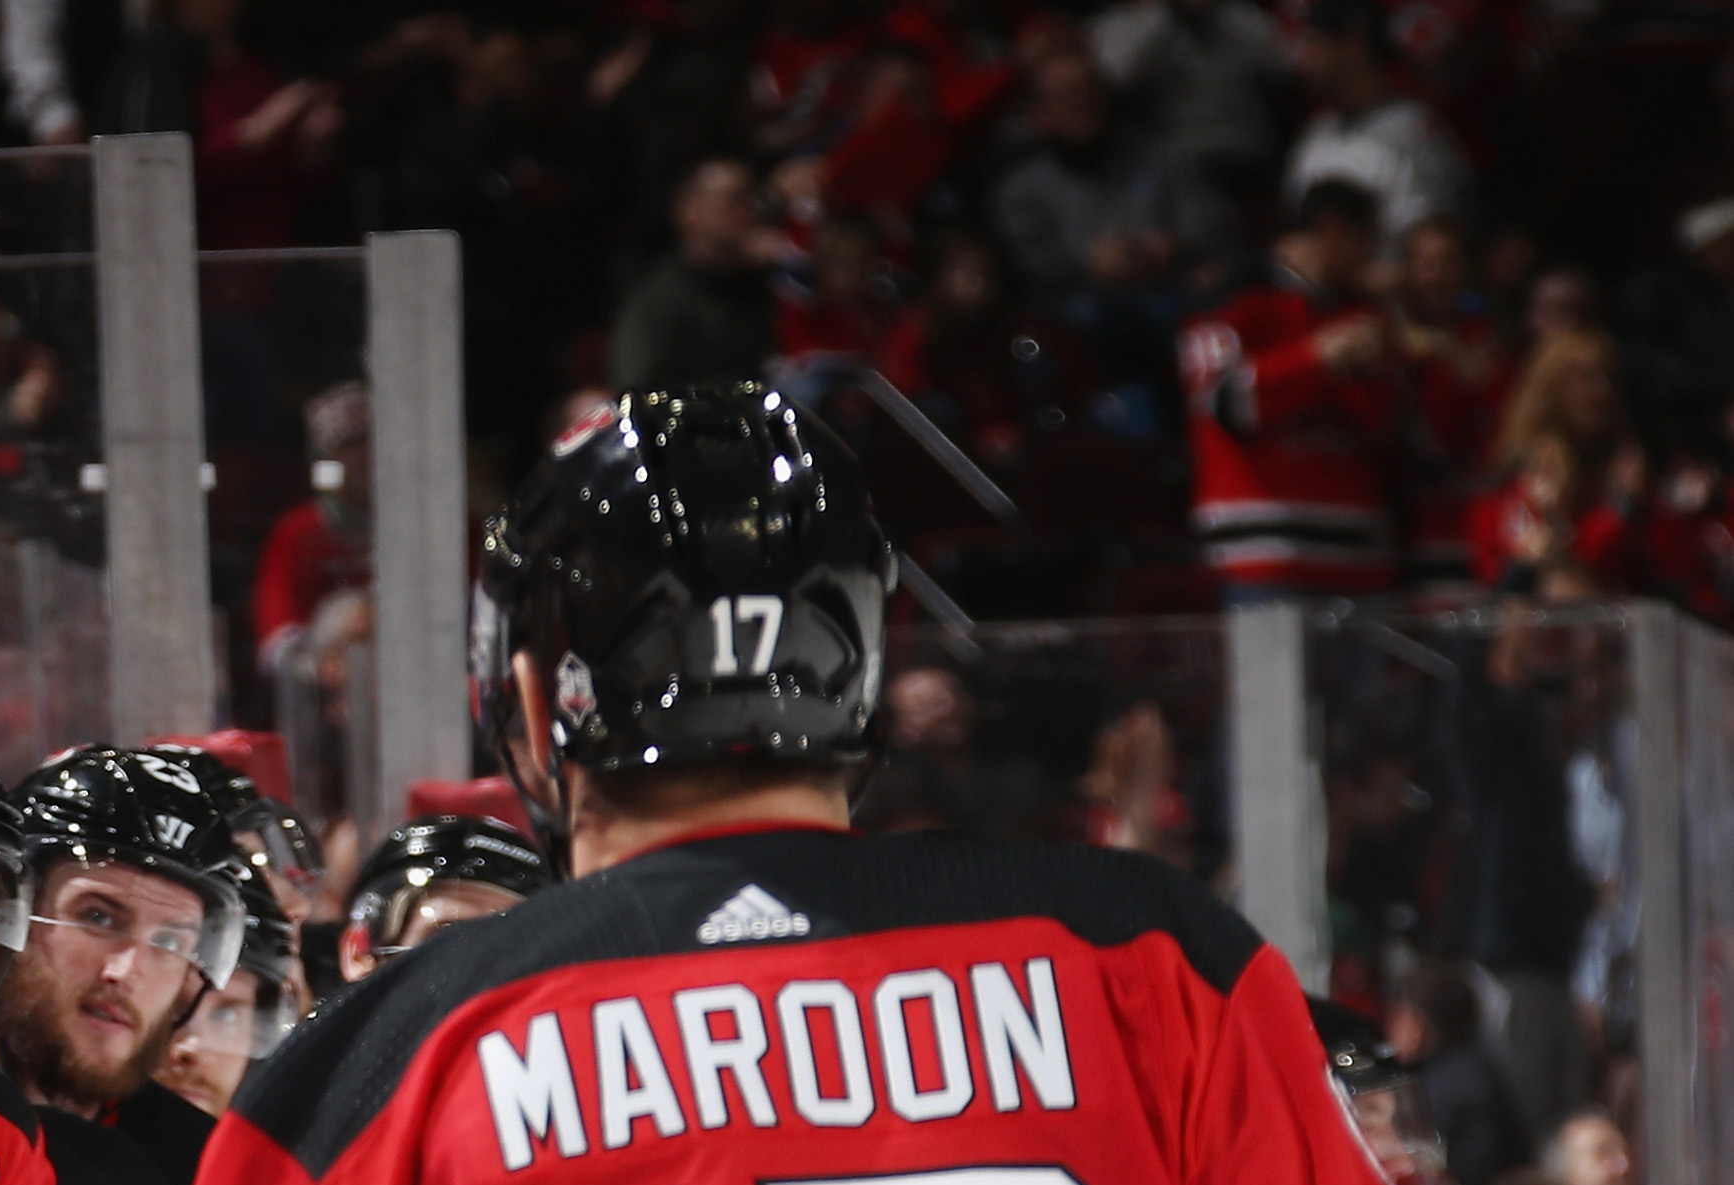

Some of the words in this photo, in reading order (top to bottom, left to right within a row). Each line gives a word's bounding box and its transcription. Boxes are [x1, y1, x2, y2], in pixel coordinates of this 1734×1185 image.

[710, 595, 783, 676] 17
[135, 753, 202, 795] 23
[475, 956, 1077, 1172] MAROON
